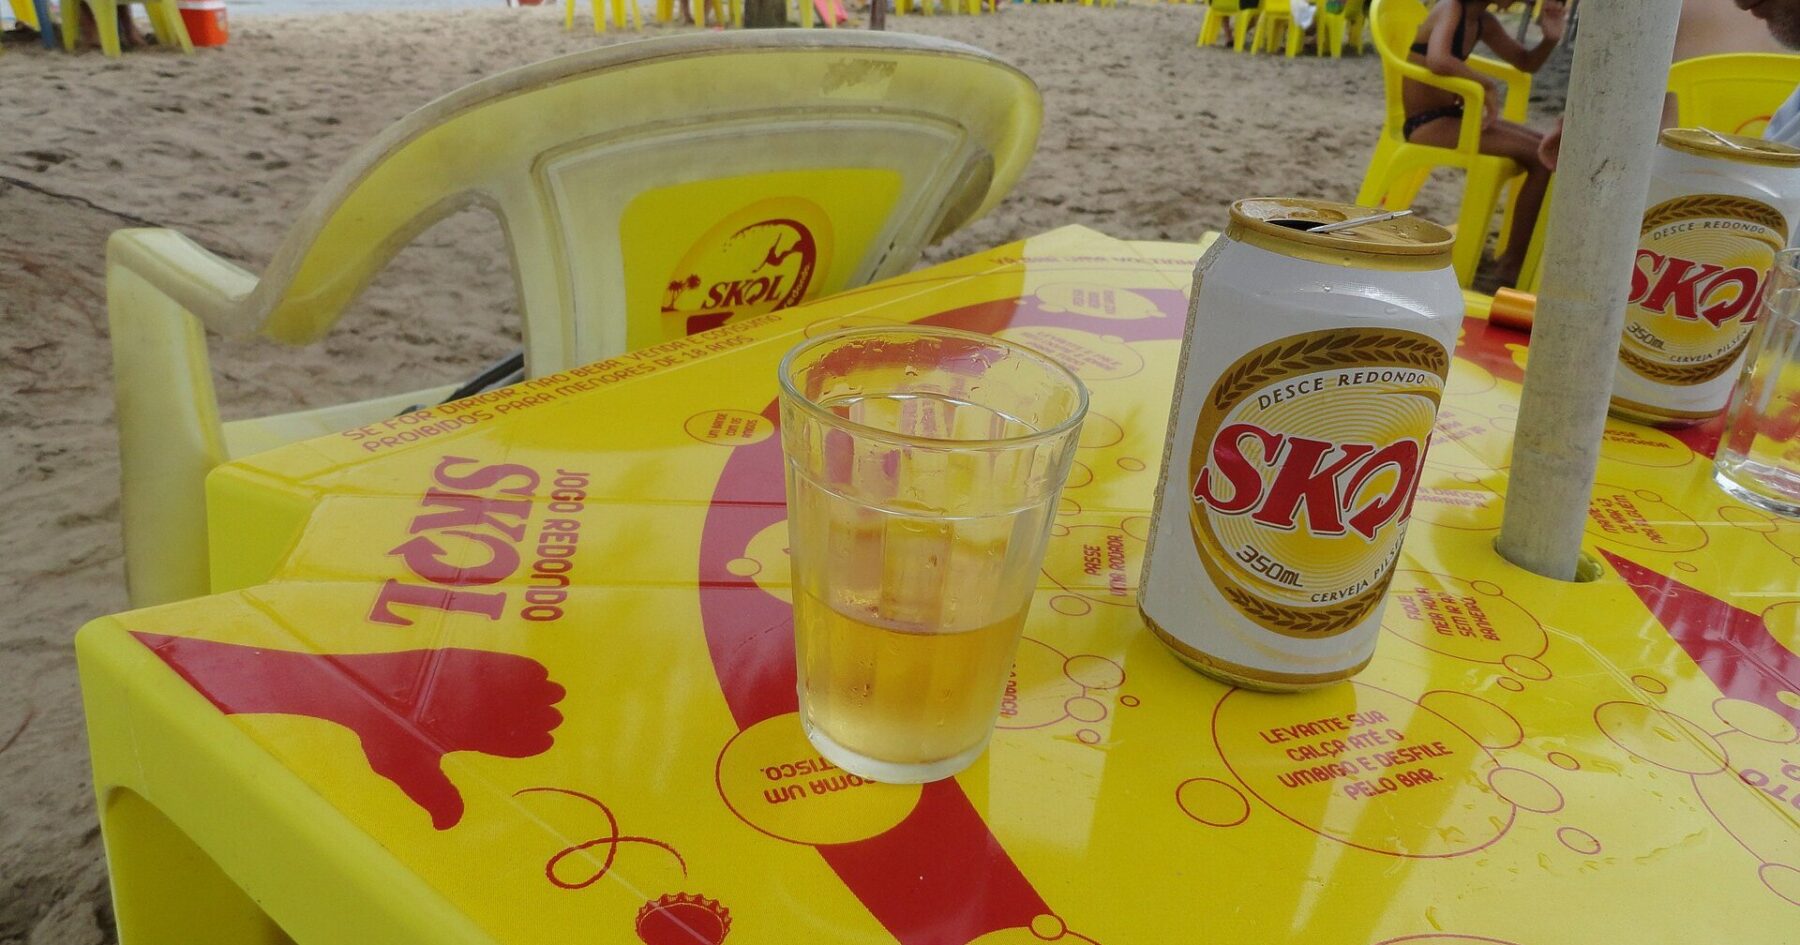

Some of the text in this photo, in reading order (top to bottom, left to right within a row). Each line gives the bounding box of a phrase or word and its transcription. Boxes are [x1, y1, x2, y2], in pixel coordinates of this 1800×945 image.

[1653, 220, 1766, 240] DESCE REDONDO
[701, 275, 785, 310] SKOL
[1670, 353, 1713, 363] CERVEJA
[342, 425, 383, 441] SE
[383, 410, 438, 430] FOR
[629, 341, 685, 362] VENDA
[362, 411, 494, 452] PROIBIDOS
[495, 390, 557, 415] PARA
[556, 363, 657, 398] MENORES
[653, 355, 684, 368] DE
[681, 347, 708, 361] 18
[1258, 370, 1425, 412] DESCE REDONDO
[367, 455, 541, 626] SKOL
[520, 468, 591, 622] JOGO REDONDO
[1083, 544, 1102, 577] PASSE
[1109, 572, 1128, 598] UMA
[1311, 579, 1369, 603] CERVEJA
[1259, 709, 1390, 745] LEVANTE SUA
[1285, 728, 1405, 762] CALÇA ATÉ O
[760, 756, 838, 782] TISCO.
[1277, 741, 1454, 788] UMBIGO E DESFILE
[763, 772, 879, 805] OMA UM
[1343, 767, 1444, 800] PELO BAR.
